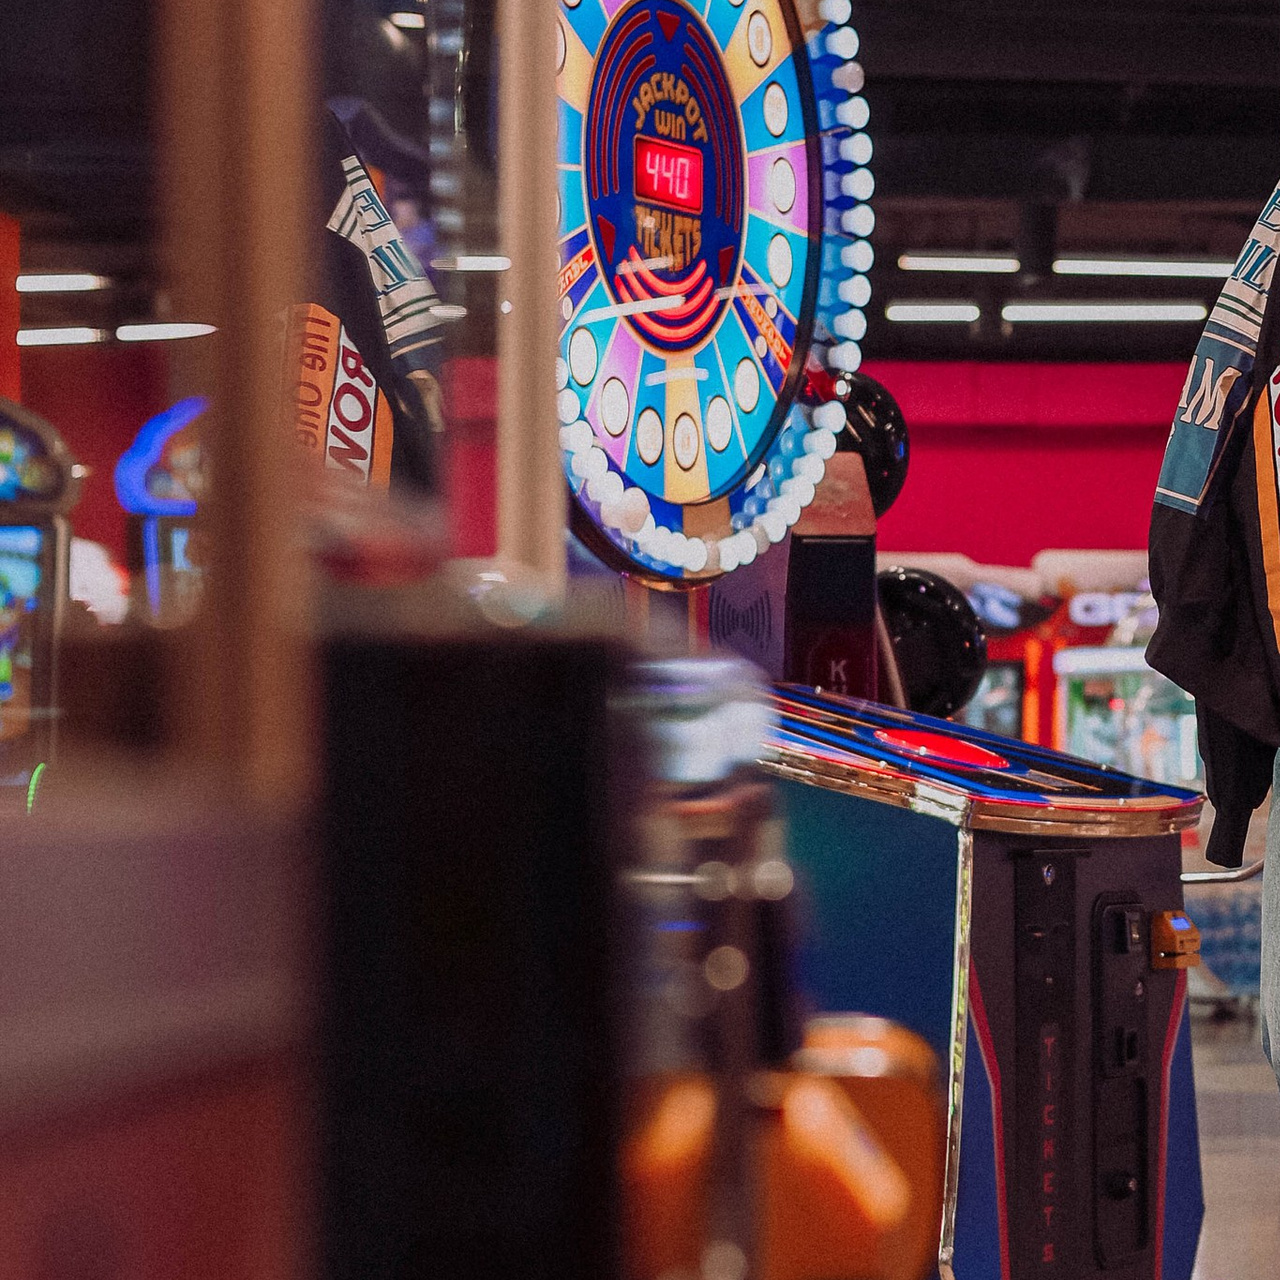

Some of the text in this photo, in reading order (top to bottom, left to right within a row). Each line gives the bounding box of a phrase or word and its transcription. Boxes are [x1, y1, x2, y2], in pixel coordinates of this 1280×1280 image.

[632, 72, 709, 143] JACKPOT
[654, 108, 686, 141] WIN
[646, 151, 690, 199] 440
[634, 205, 702, 273] TICKETS
[1043, 1036, 1056, 1262] TICKETS
